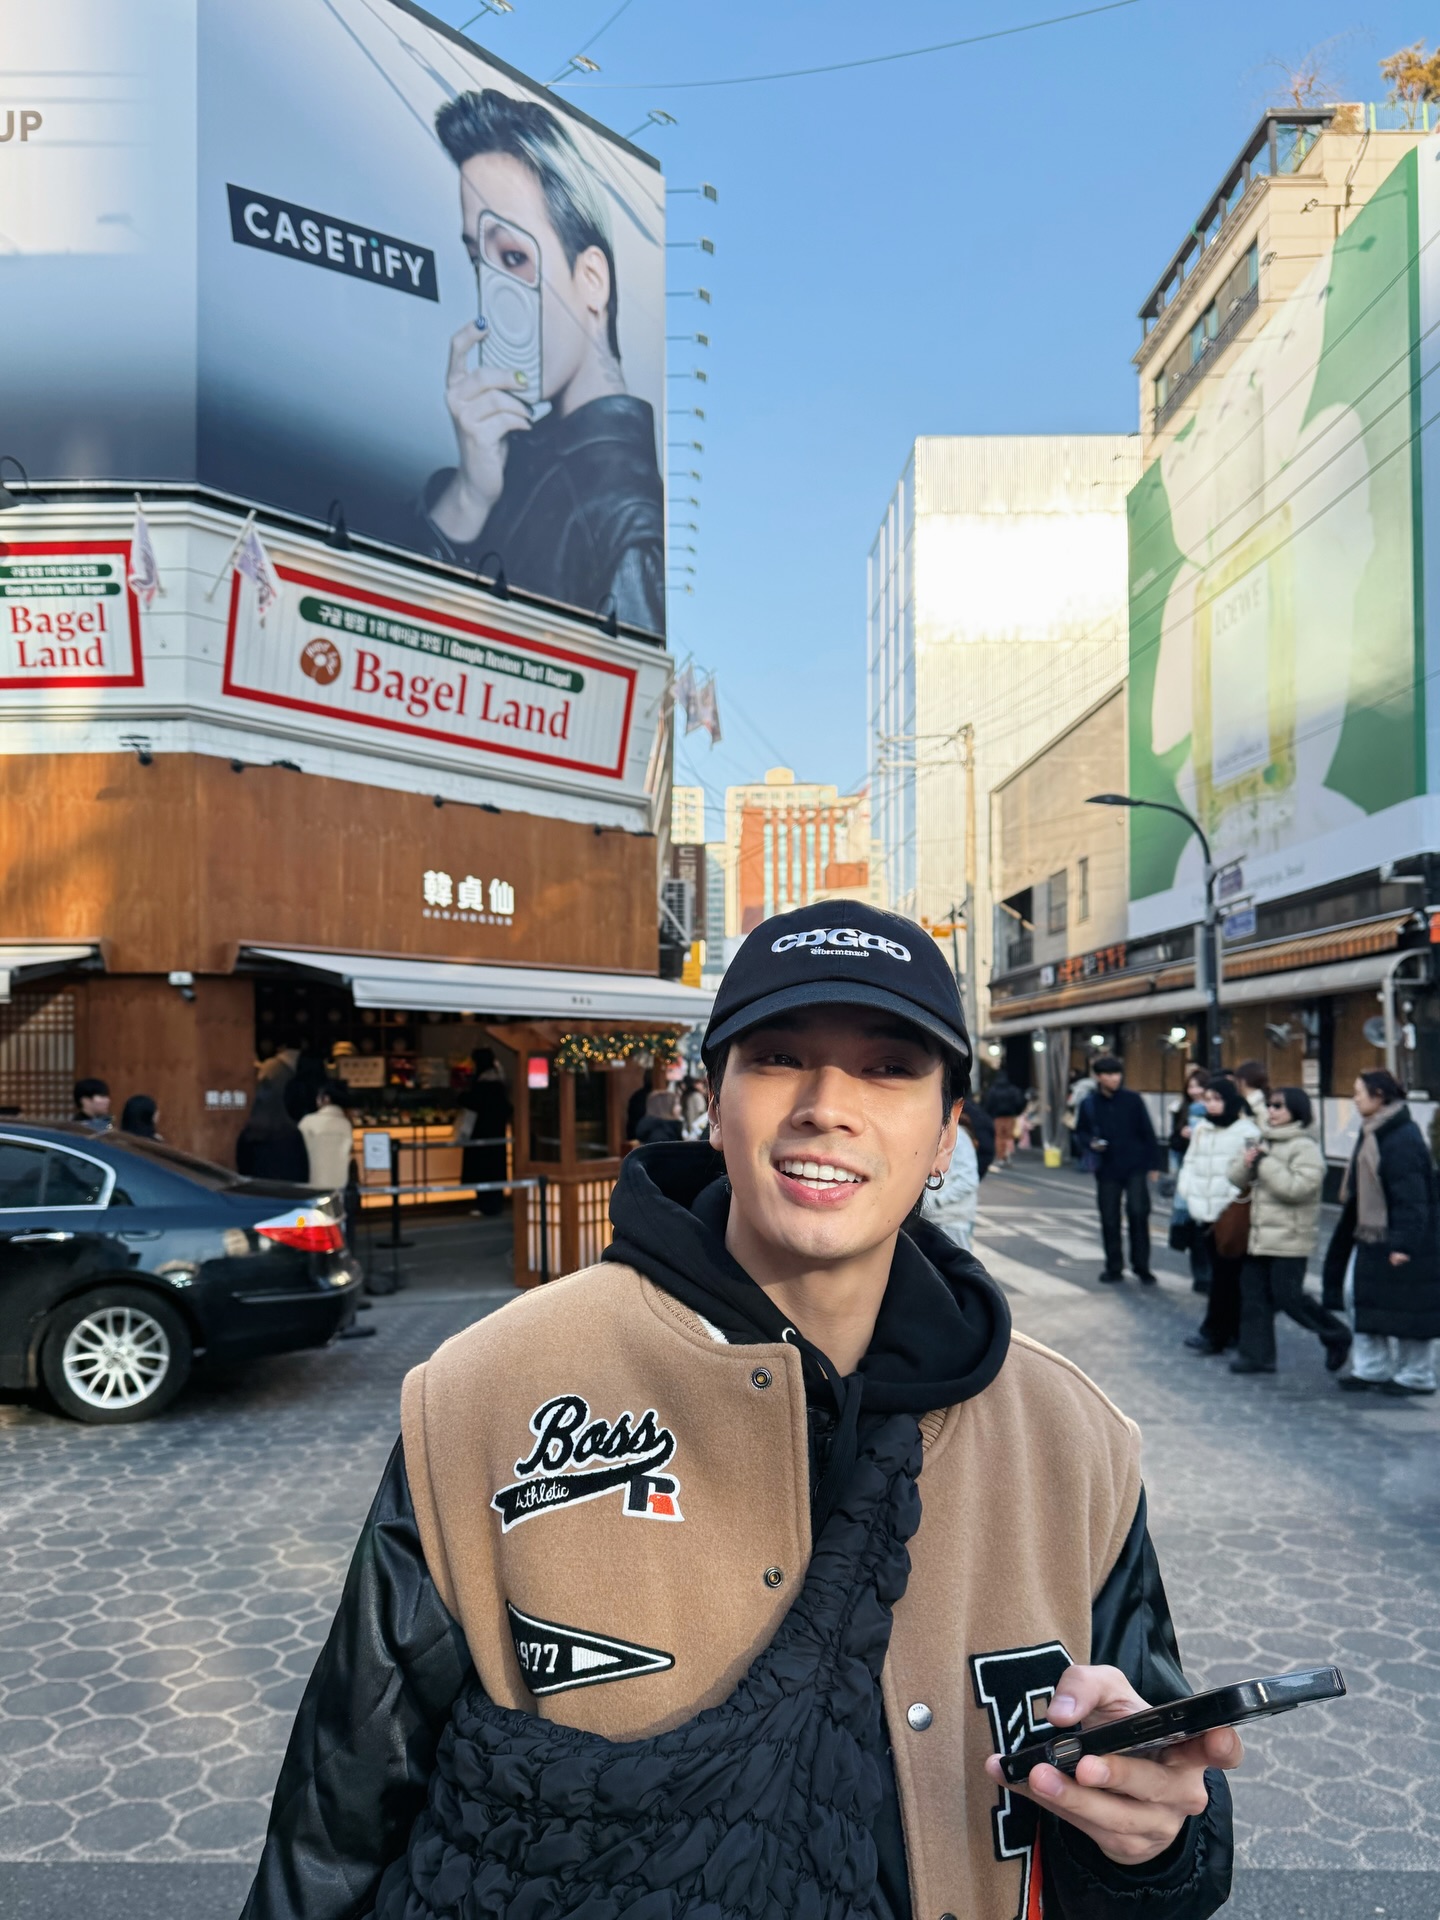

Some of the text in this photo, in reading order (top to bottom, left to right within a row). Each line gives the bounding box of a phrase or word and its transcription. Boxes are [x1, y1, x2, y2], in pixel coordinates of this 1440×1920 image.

[8, 602, 108, 641] Bagel
[16, 637, 105, 668] Land
[353, 648, 468, 718] Bagel
[479, 681, 571, 740] Land
[514, 1393, 676, 1476] Boss
[514, 1479, 570, 1510] Athletic
